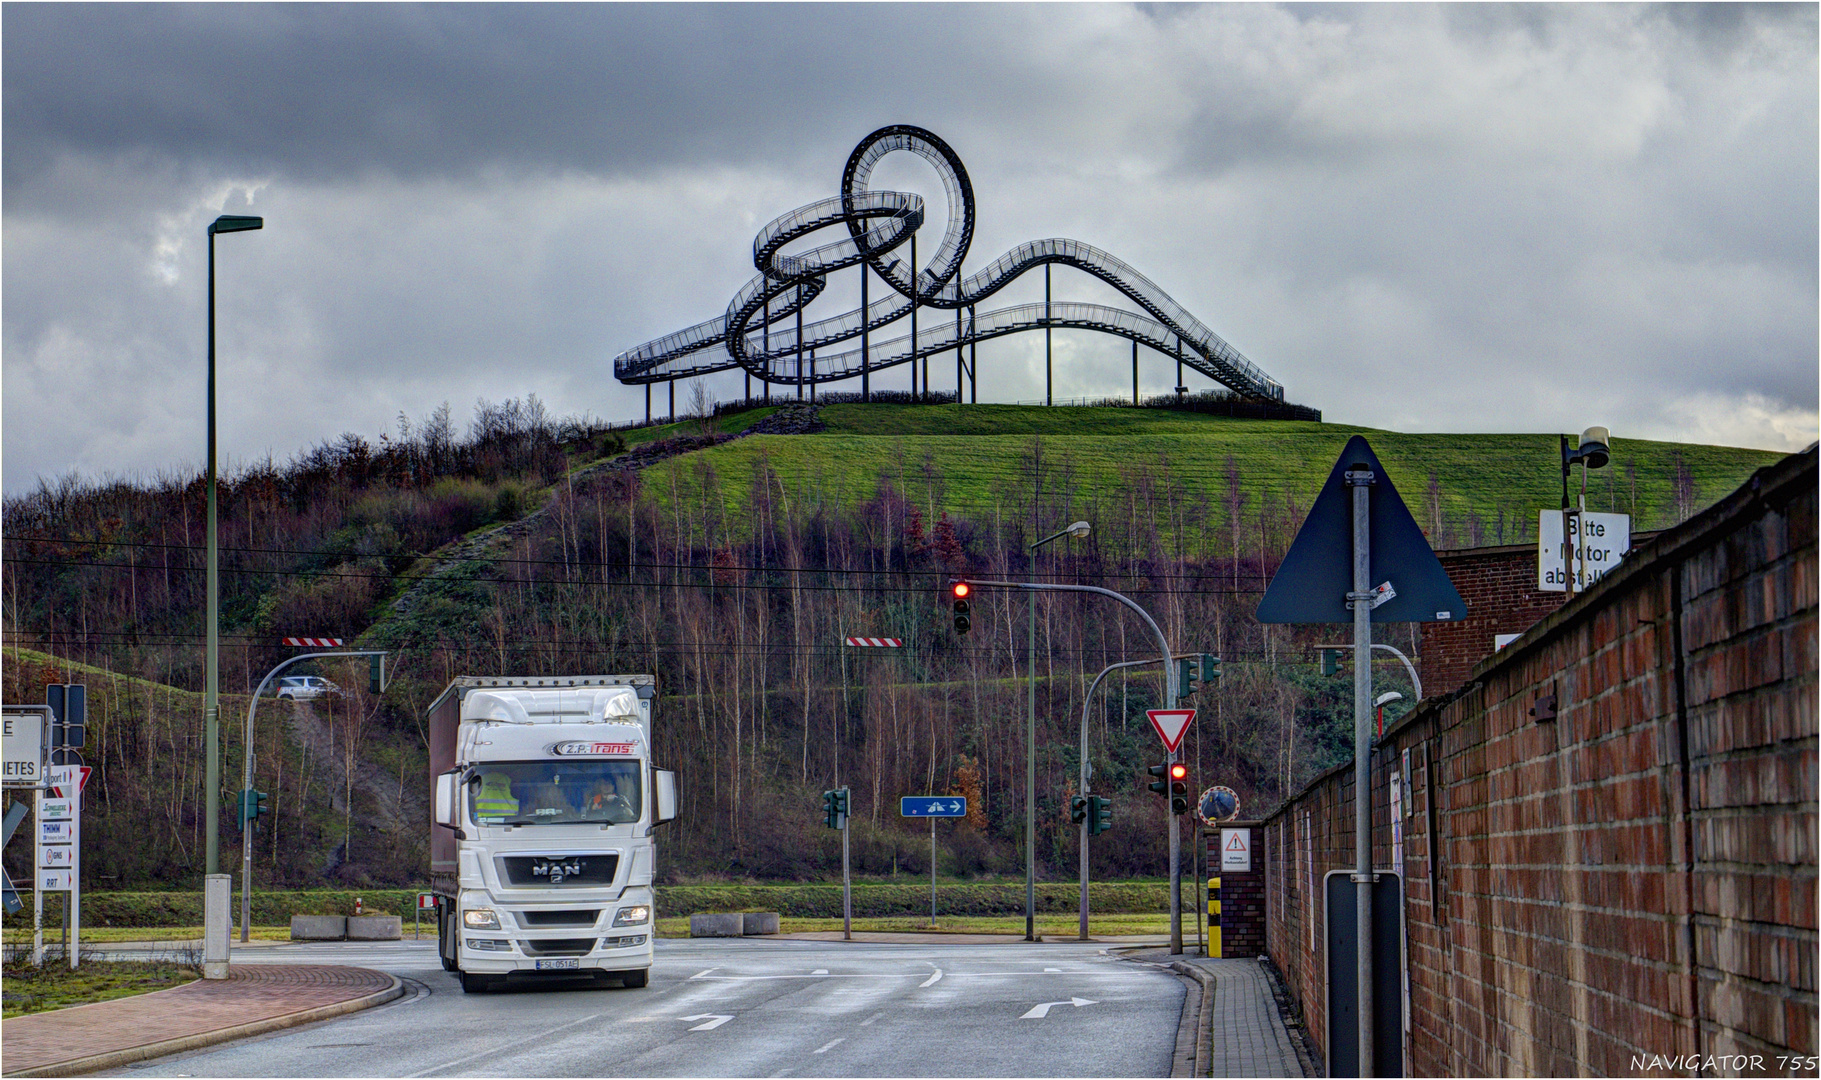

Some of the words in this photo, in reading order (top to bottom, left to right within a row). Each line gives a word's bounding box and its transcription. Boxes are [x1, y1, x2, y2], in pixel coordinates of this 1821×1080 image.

[1567, 518, 1605, 537] Btte
[532, 865, 580, 876] MAN
[46, 878, 58, 888] RRT
